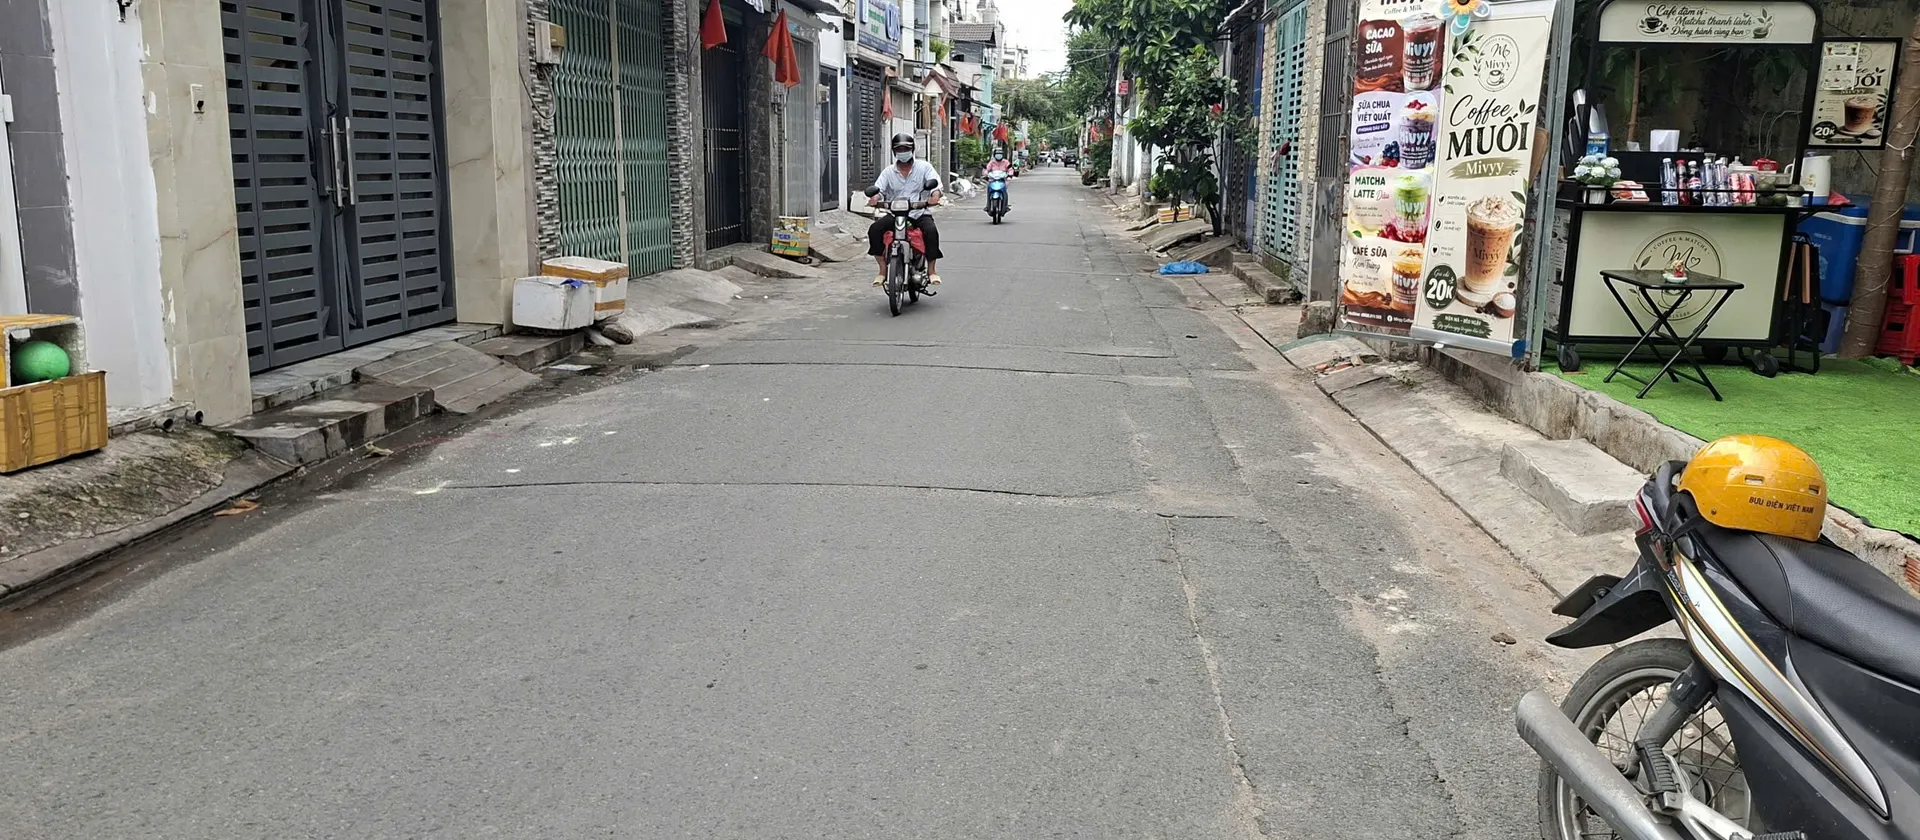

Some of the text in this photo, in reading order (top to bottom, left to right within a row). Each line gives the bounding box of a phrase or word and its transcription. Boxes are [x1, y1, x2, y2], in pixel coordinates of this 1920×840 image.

[1384, 7, 1402, 15] Coffee
[1656, 4, 1677, 19] Café
[1678, 6, 1695, 16] đậm
[1674, 16, 1706, 26] Matcha
[1707, 16, 1732, 26] thanh
[1733, 16, 1752, 26] lành
[1365, 27, 1396, 40] CACAO
[1695, 27, 1712, 36] hành
[1714, 28, 1730, 38] cùng
[1365, 41, 1383, 54] SỮA
[1358, 100, 1391, 110] SỮA CHUA
[1449, 94, 1514, 127] Coffee
[1357, 111, 1392, 123] VIỆT QUẤT
[1446, 113, 1530, 161] MUỐI
[1465, 161, 1505, 176] Mivyy
[1354, 176, 1386, 186] MATCHA
[1353, 189, 1375, 199] LATTE
[1653, 236, 1677, 250] COFFEE
[1684, 237, 1708, 252] MATCHA
[1352, 245, 1388, 258] CAFÉ SỮA
[1426, 278, 1455, 301] 20K
[1765, 499, 1784, 511] ĐIỆN
[1785, 502, 1801, 513] VIỆT
[1801, 505, 1815, 515] NAM
